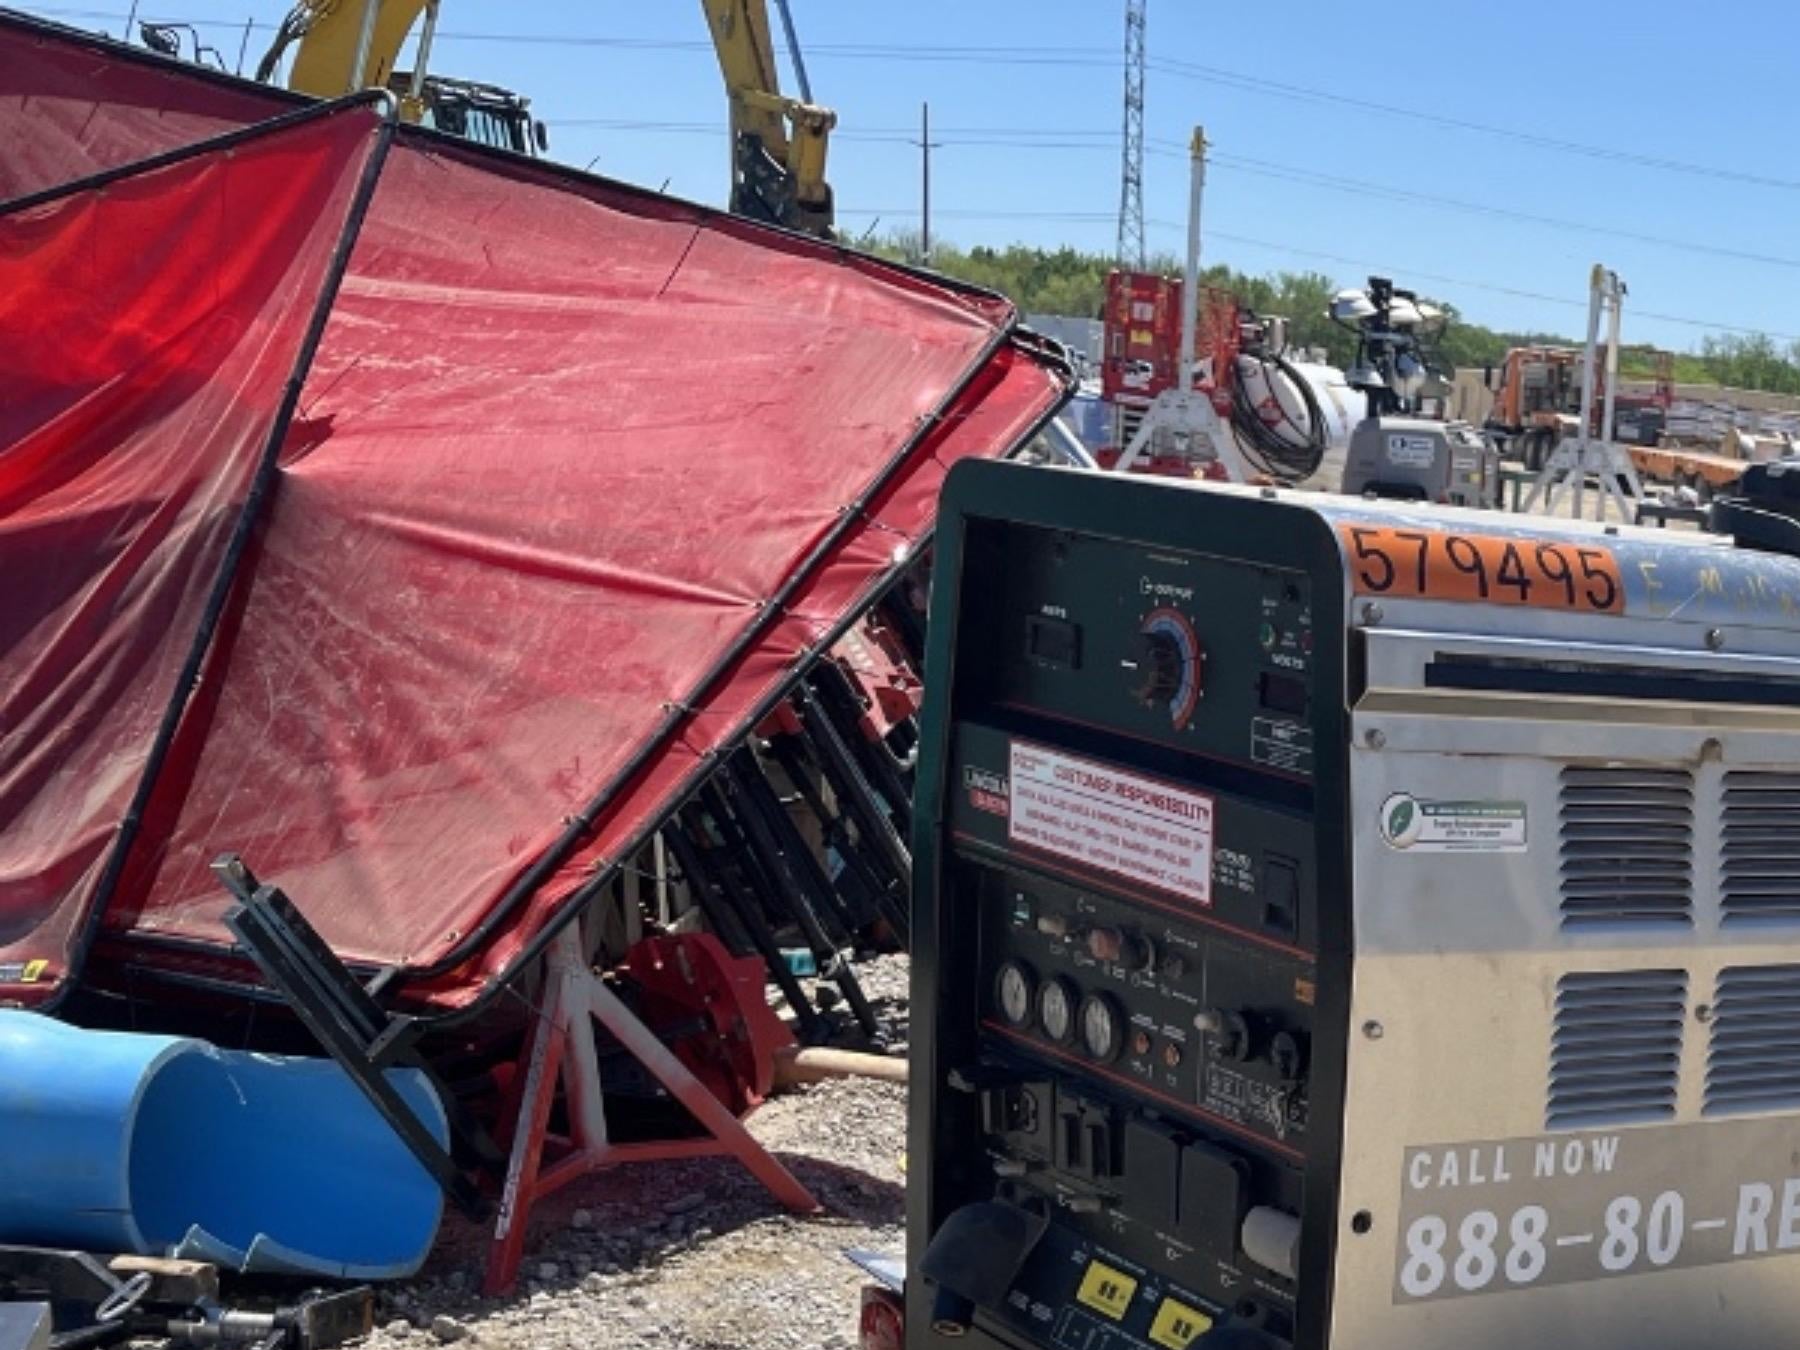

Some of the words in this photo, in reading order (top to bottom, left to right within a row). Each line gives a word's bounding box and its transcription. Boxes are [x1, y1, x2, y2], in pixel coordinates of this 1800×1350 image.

[1349, 526, 1618, 611] 579495
[1409, 1144, 1513, 1190] CALL
[1533, 1135, 1622, 1178] NOW
